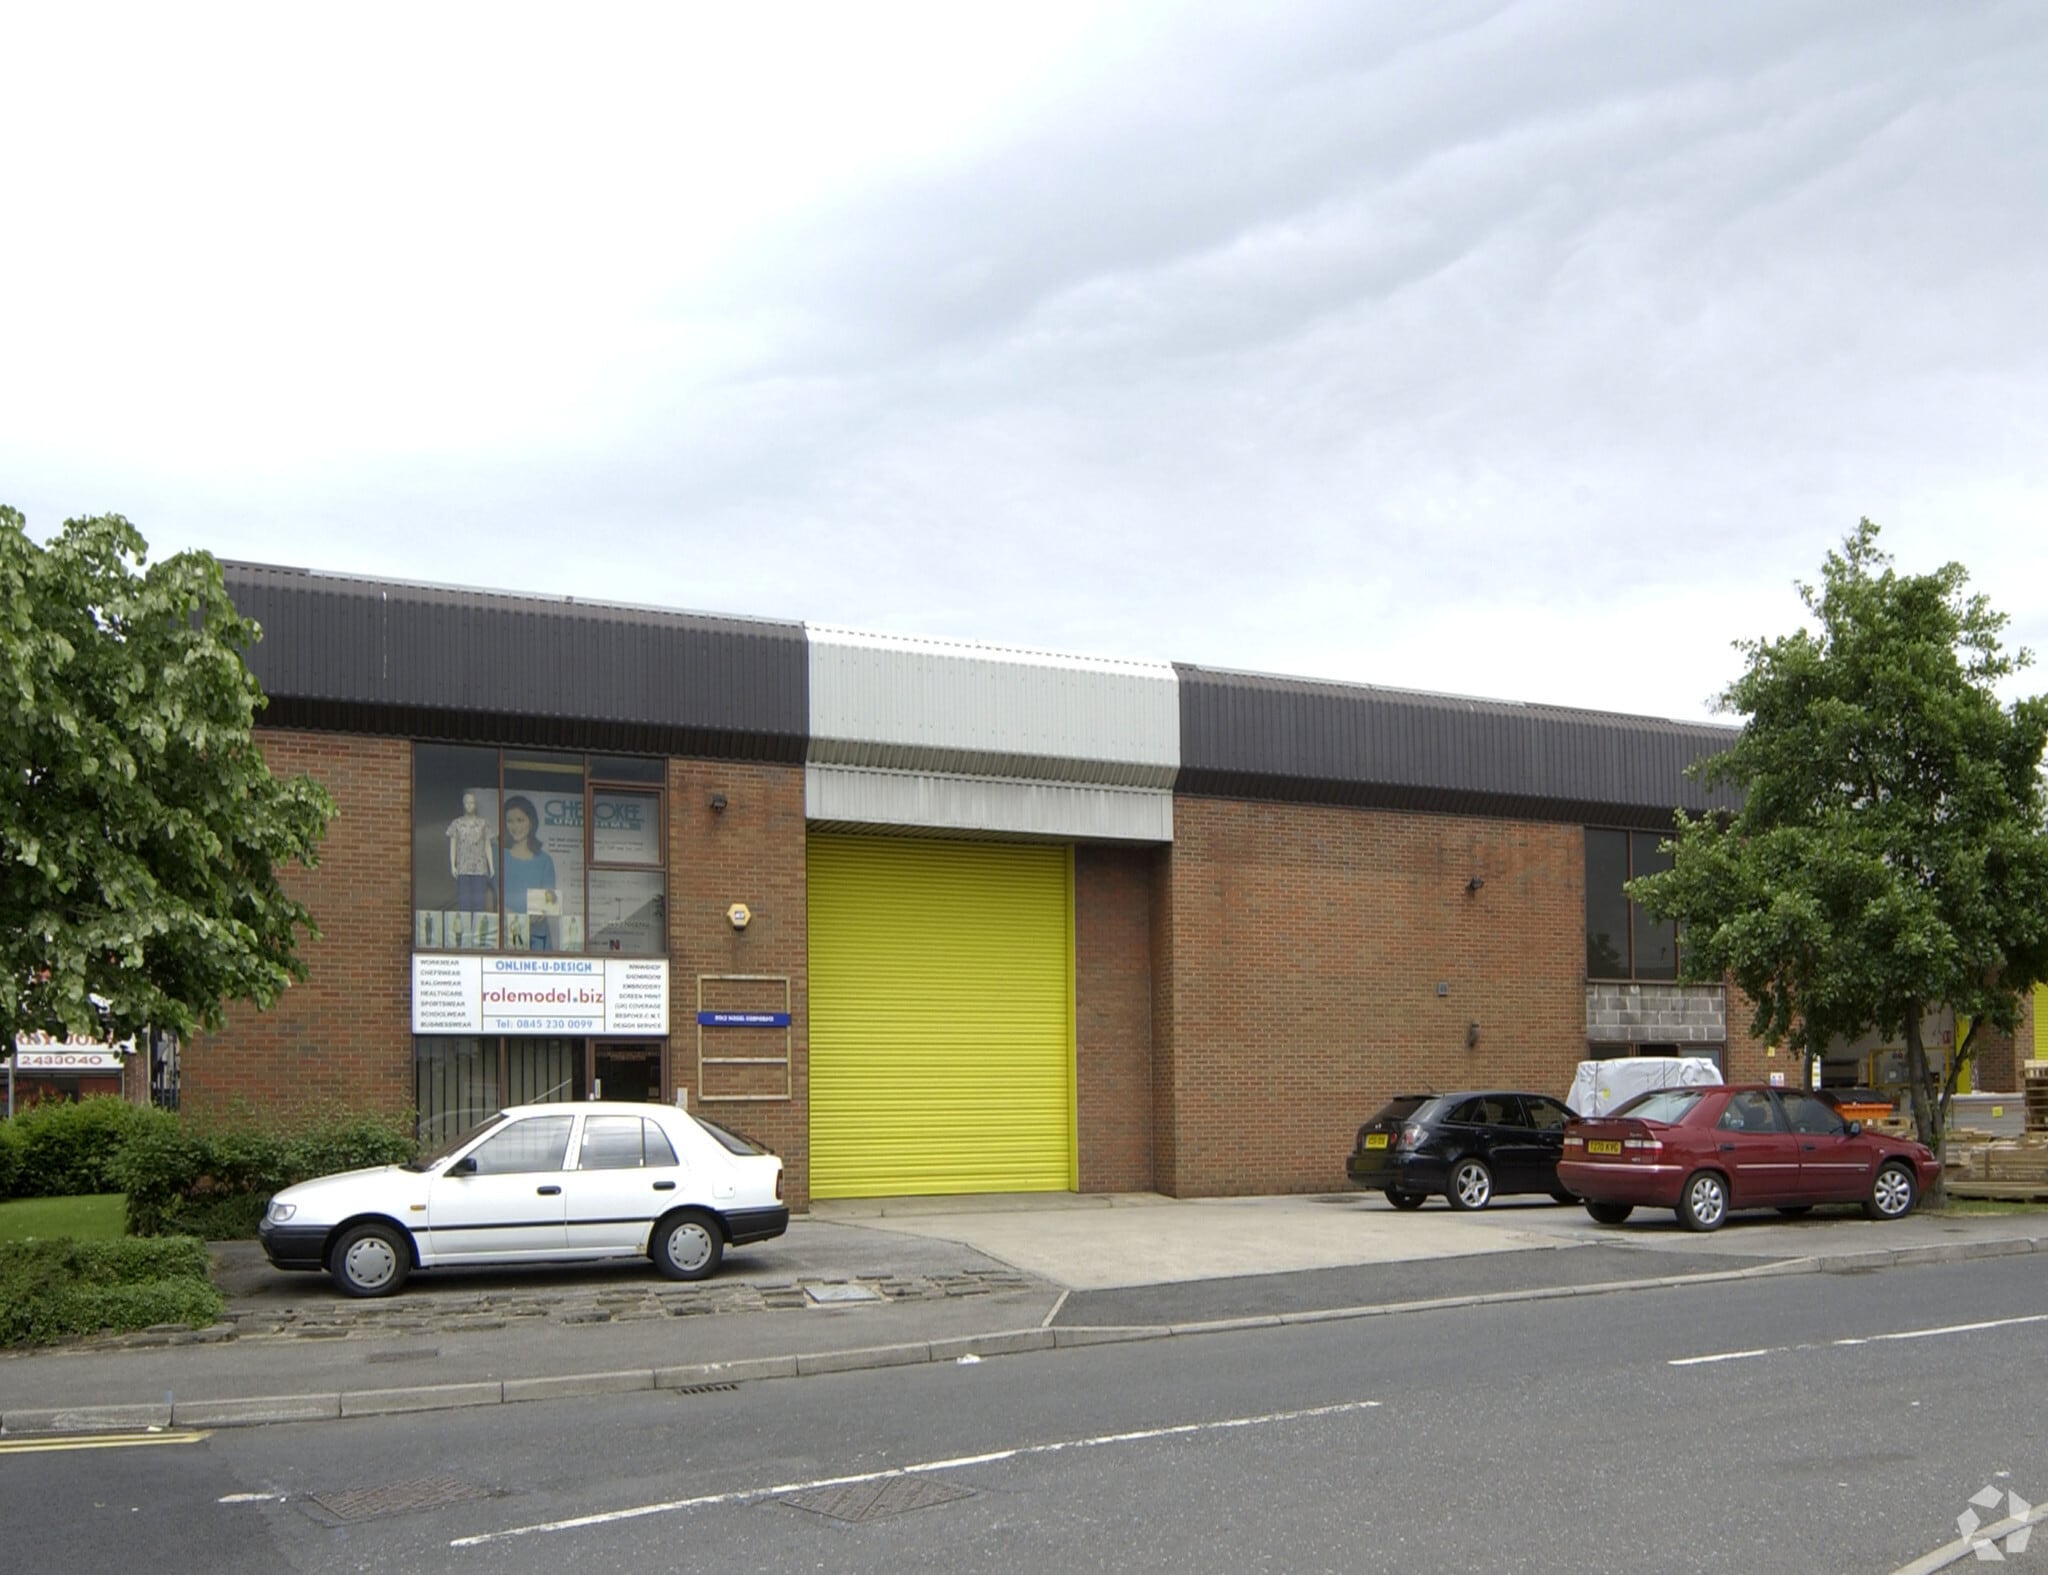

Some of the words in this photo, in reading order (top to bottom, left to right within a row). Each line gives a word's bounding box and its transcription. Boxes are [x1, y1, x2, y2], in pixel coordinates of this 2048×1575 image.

[545, 800, 644, 823] CHEOKEE
[482, 987, 604, 1003] rolemodel.biz
[516, 1020, 542, 1029] 0845
[546, 1020, 565, 1029] 230
[567, 1021, 593, 1029] 0099
